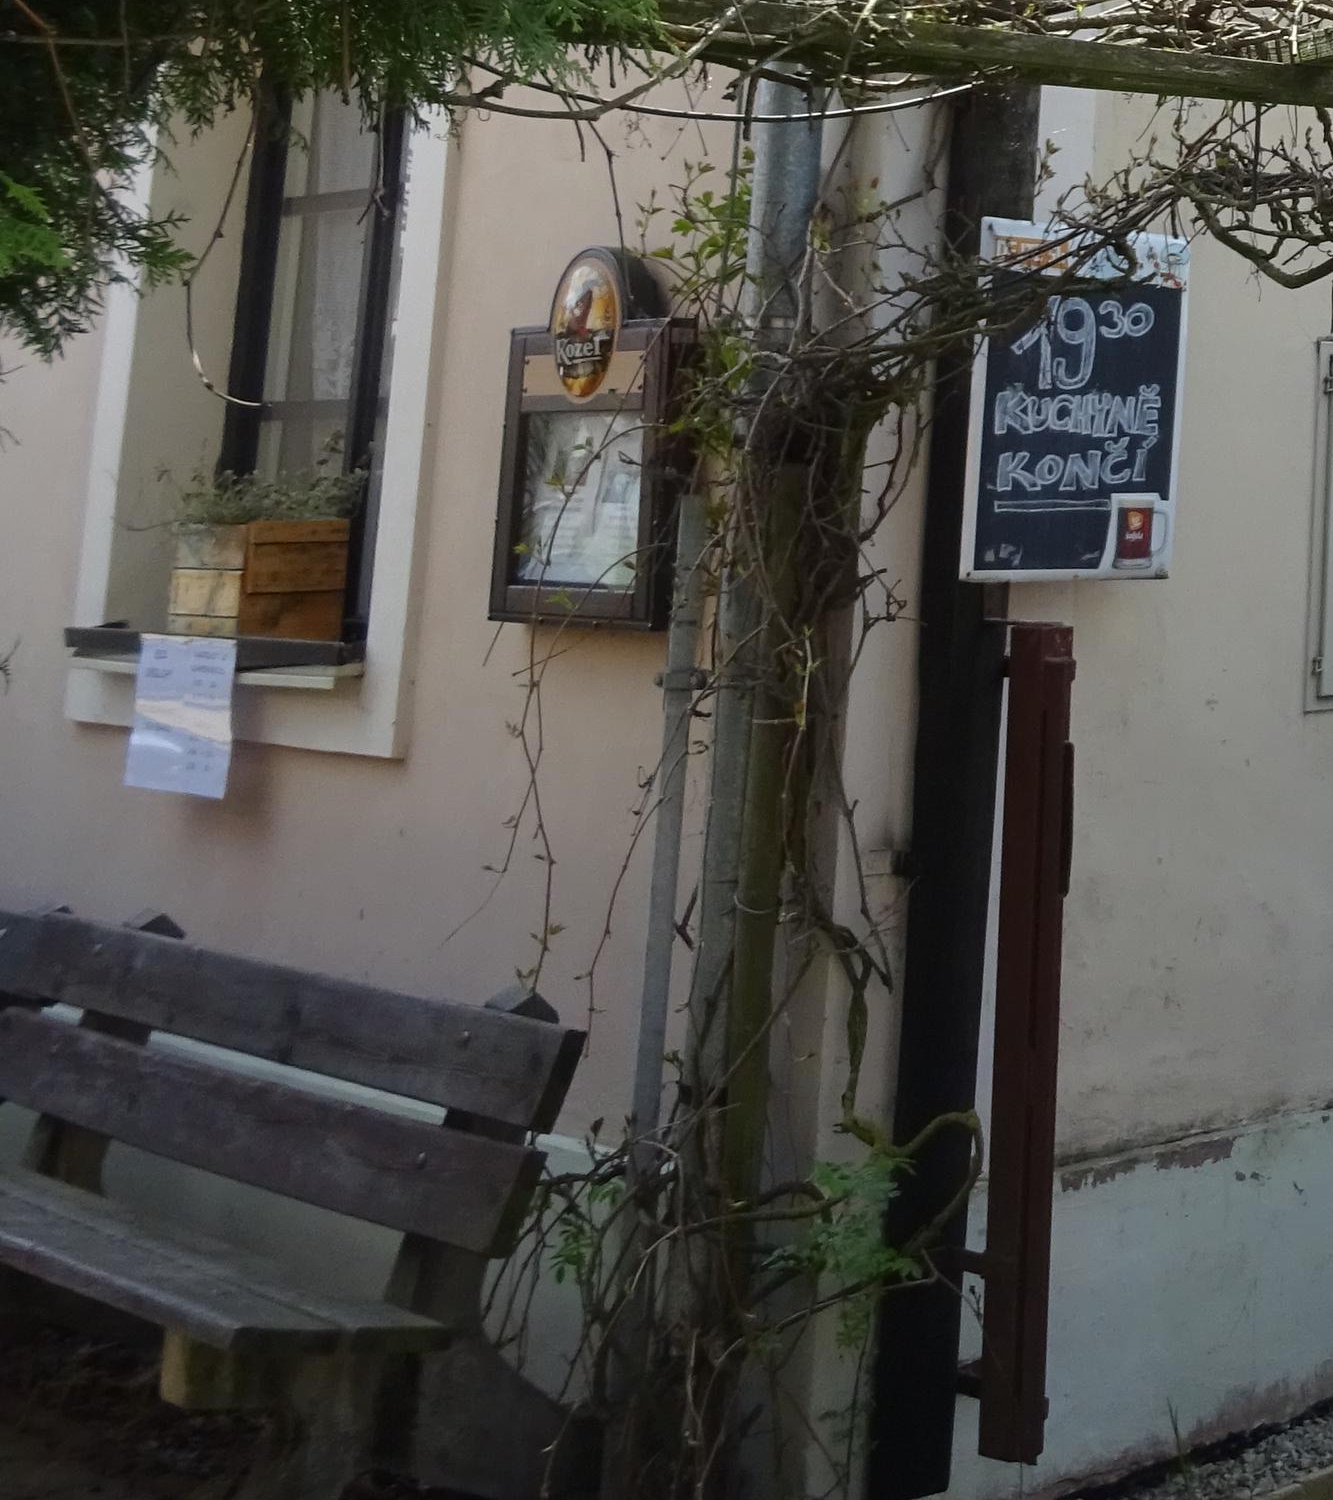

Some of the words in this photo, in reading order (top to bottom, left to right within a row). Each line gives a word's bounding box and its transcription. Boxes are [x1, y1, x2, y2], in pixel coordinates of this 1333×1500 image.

[556, 332, 605, 366] Kozel
[995, 383, 1162, 438] KUCHYNĚ
[996, 435, 1159, 491] KONČÍ
